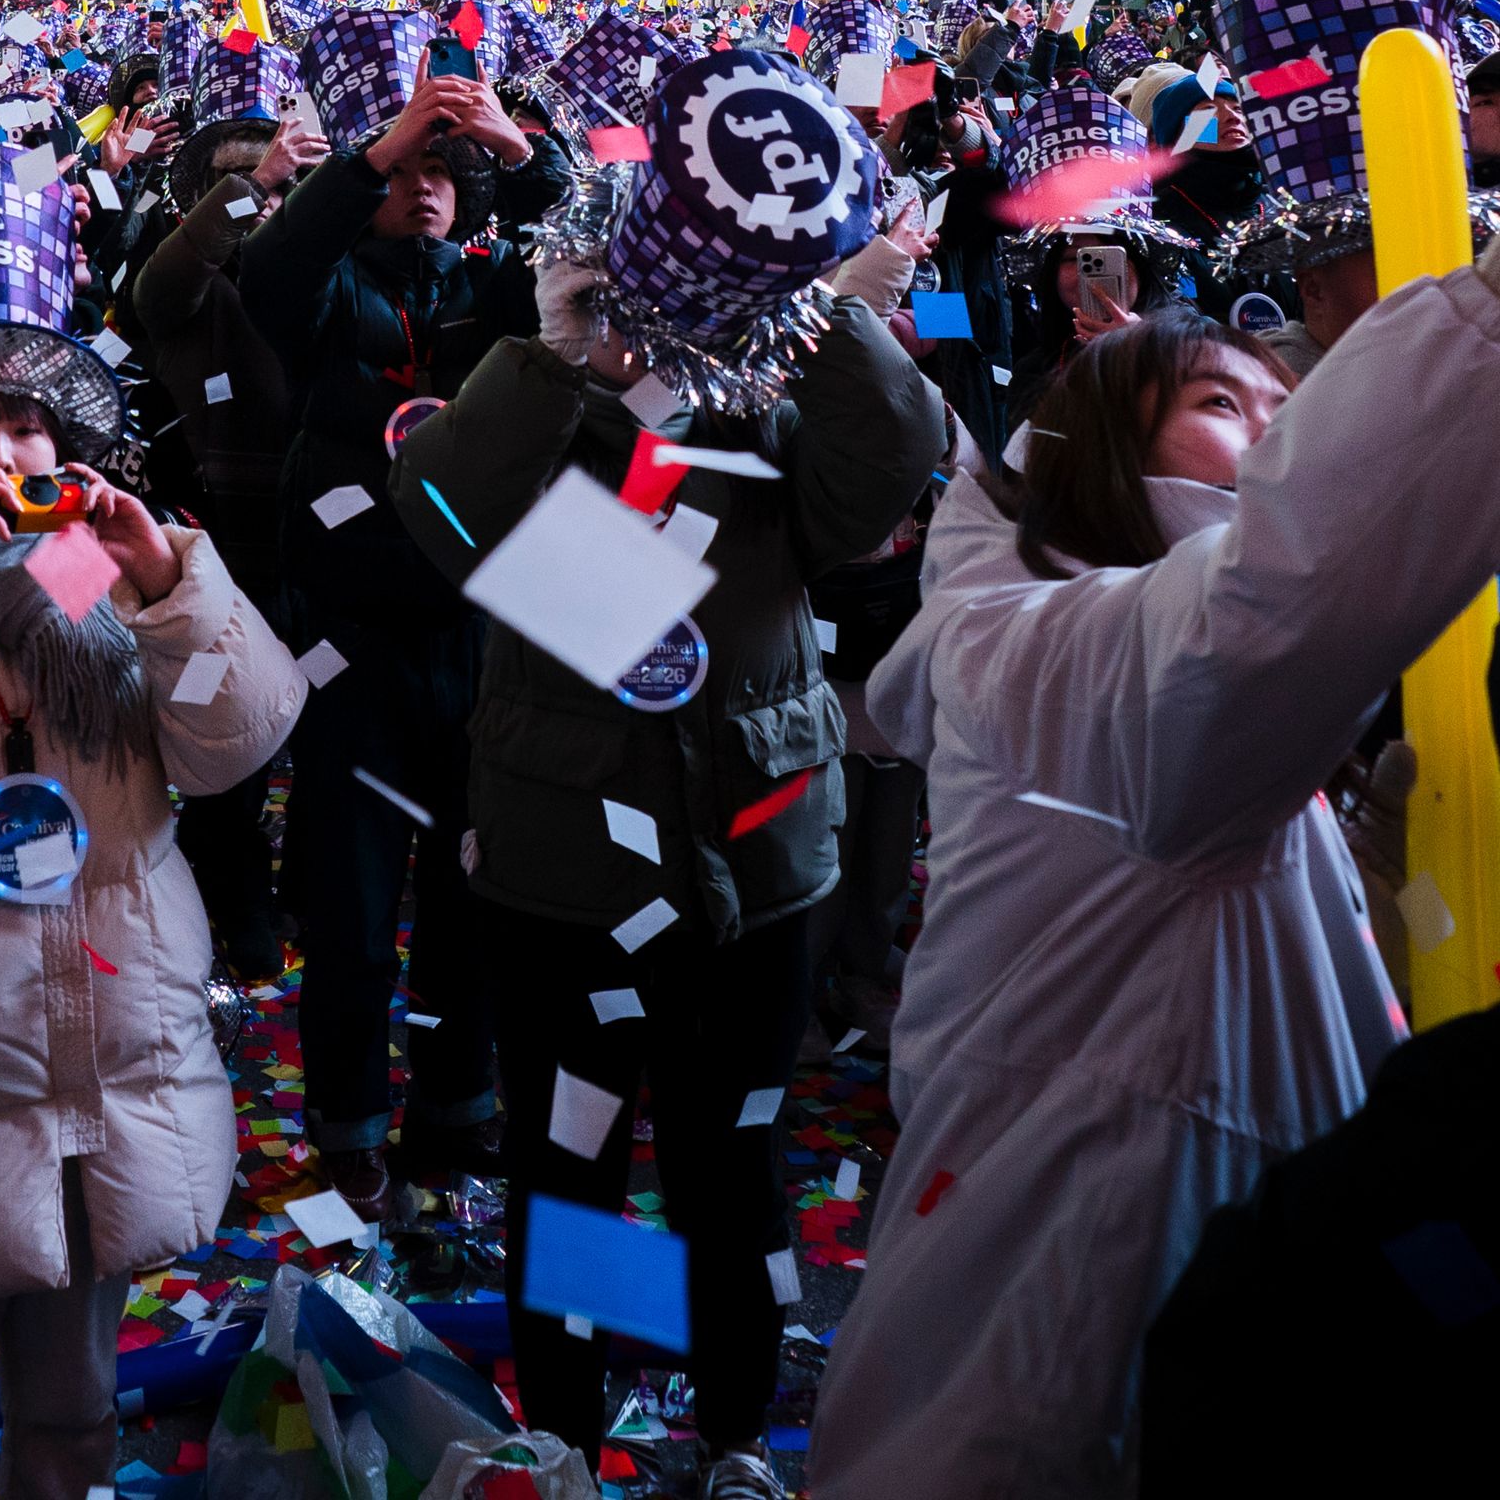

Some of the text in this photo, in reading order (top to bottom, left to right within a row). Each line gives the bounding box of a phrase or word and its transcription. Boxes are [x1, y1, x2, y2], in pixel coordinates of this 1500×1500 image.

[615, 77, 646, 126] fitn
[1248, 87, 1360, 134] nes
[1014, 126, 1122, 173] planet
[1247, 315, 1280, 323] Carnival
[652, 641, 694, 654] rnival
[2, 817, 72, 837] Canival
